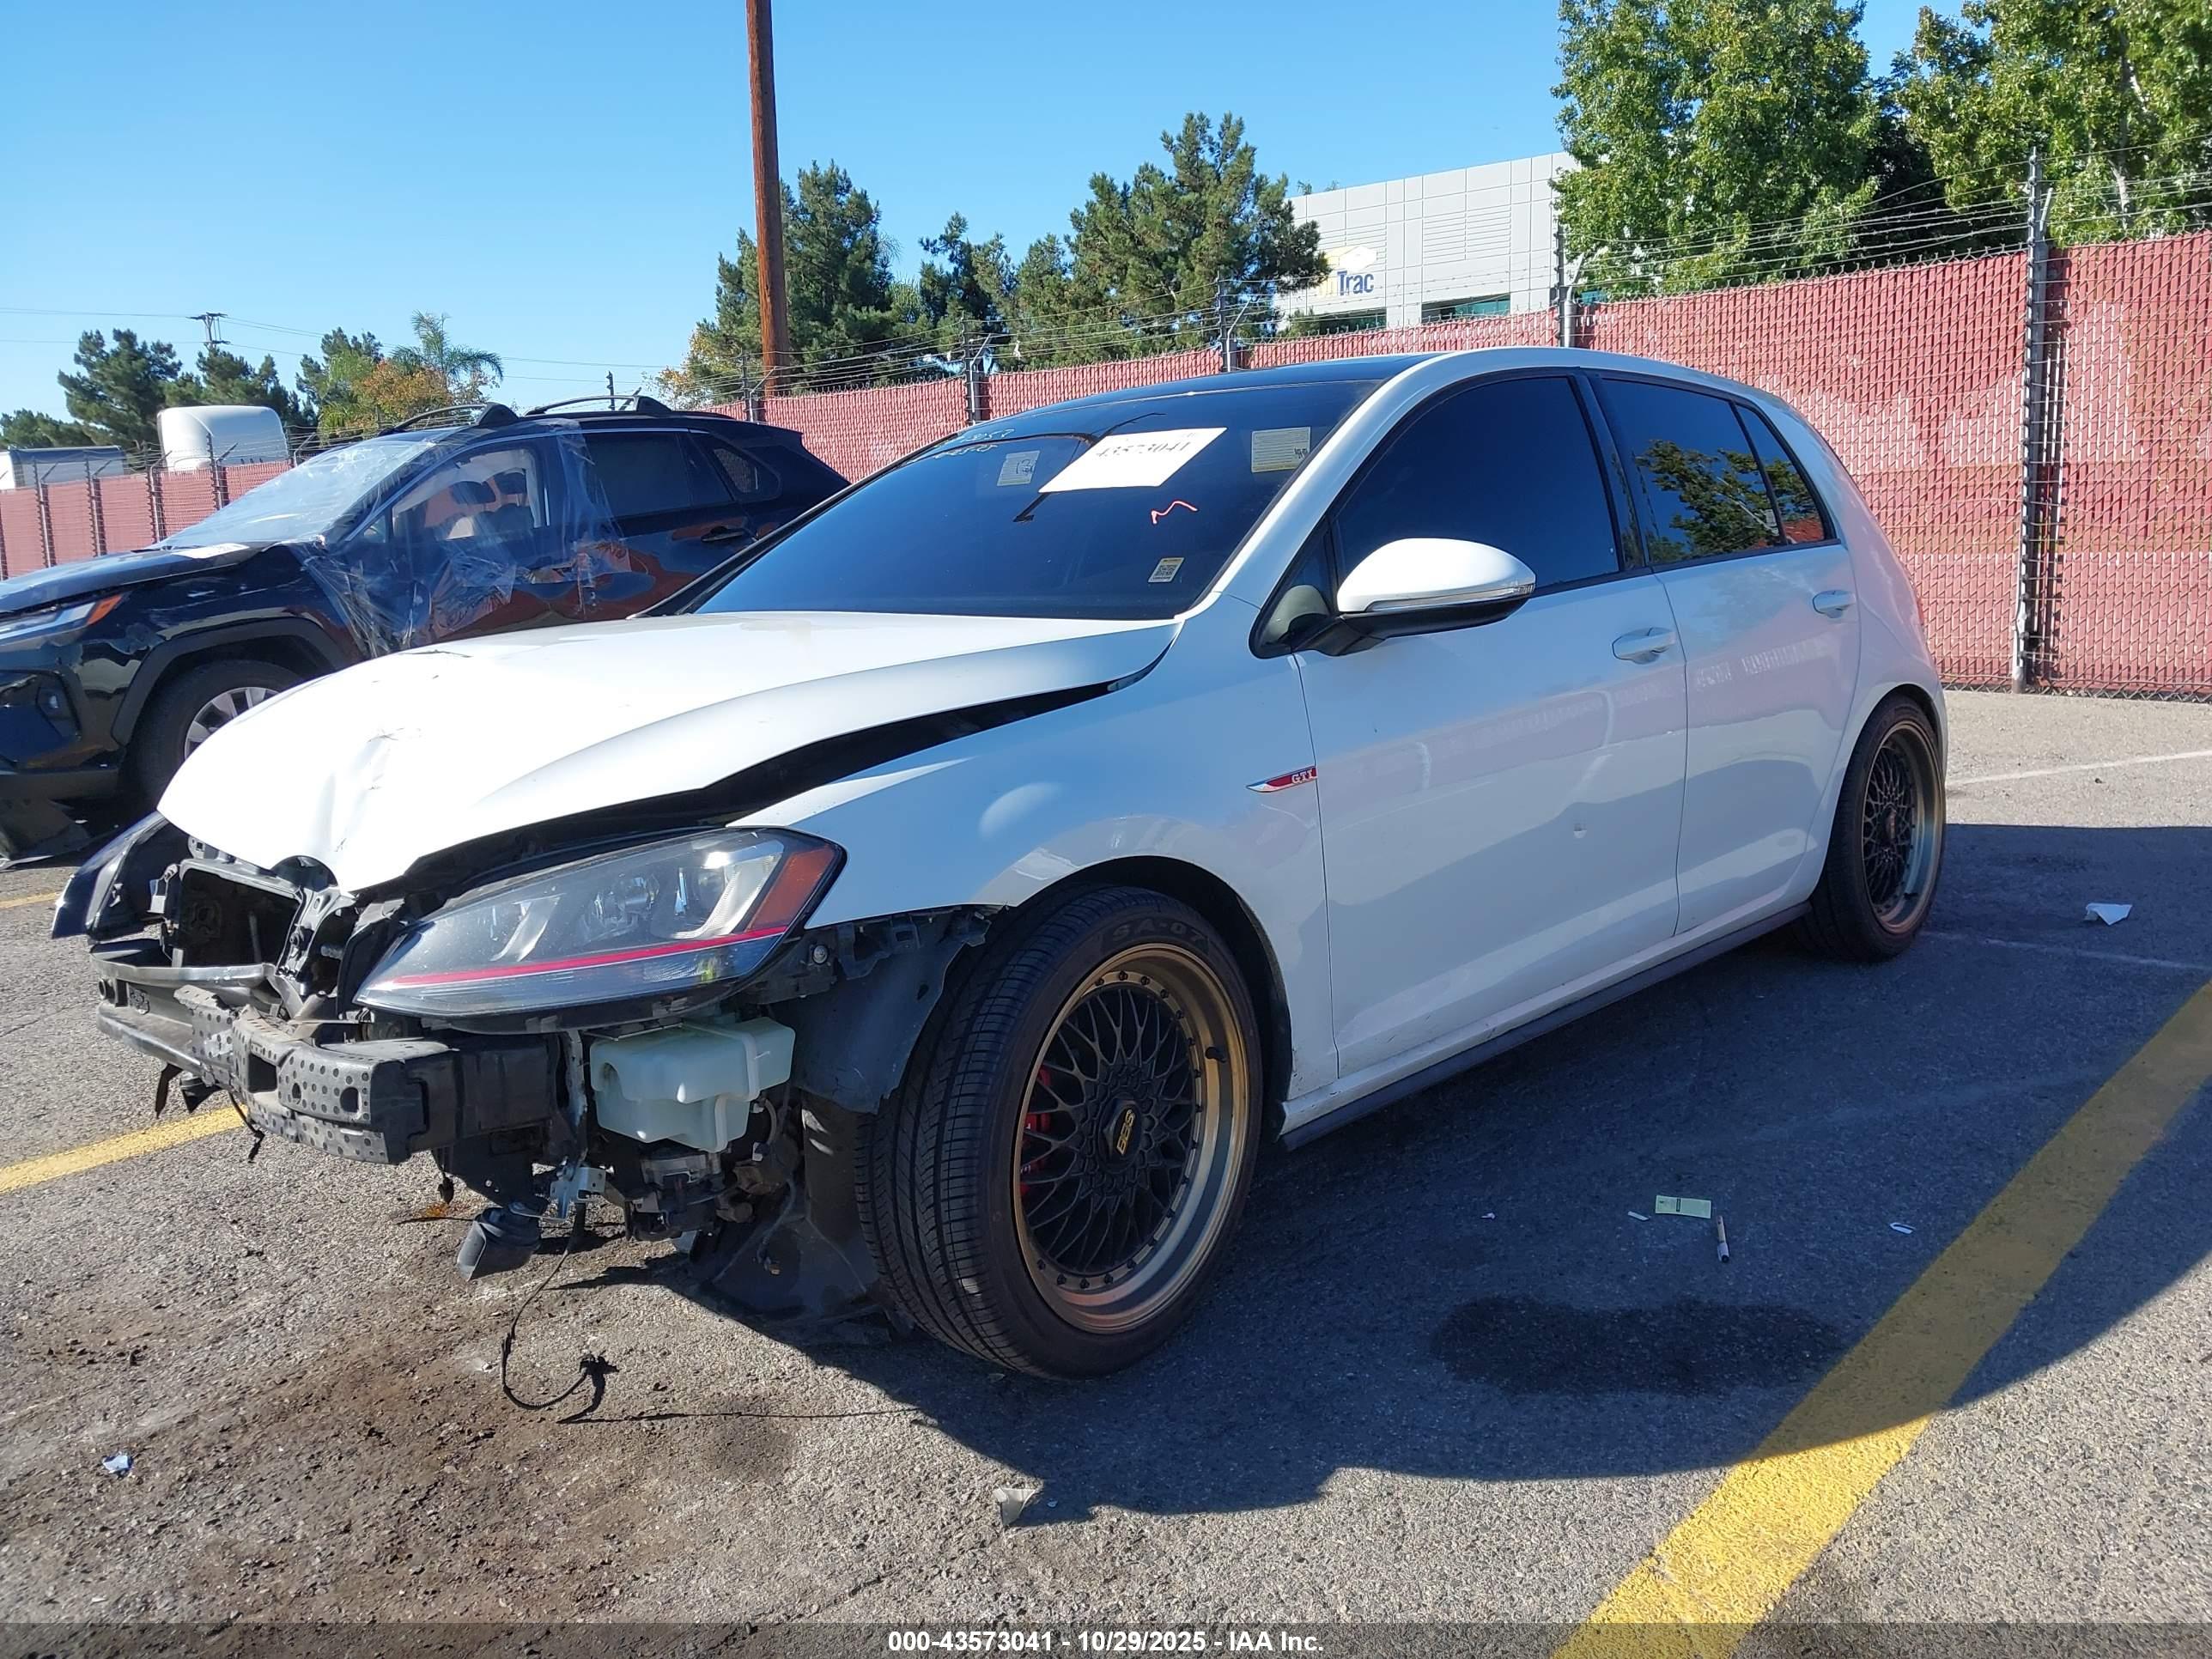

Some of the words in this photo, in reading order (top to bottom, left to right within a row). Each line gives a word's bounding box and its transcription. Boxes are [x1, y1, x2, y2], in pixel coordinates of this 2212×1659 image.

[1337, 270, 1374, 295] Trac
[1291, 769, 1313, 783] GTI
[1112, 918, 1206, 943] SA-07
[1116, 1109, 1136, 1155] BBS
